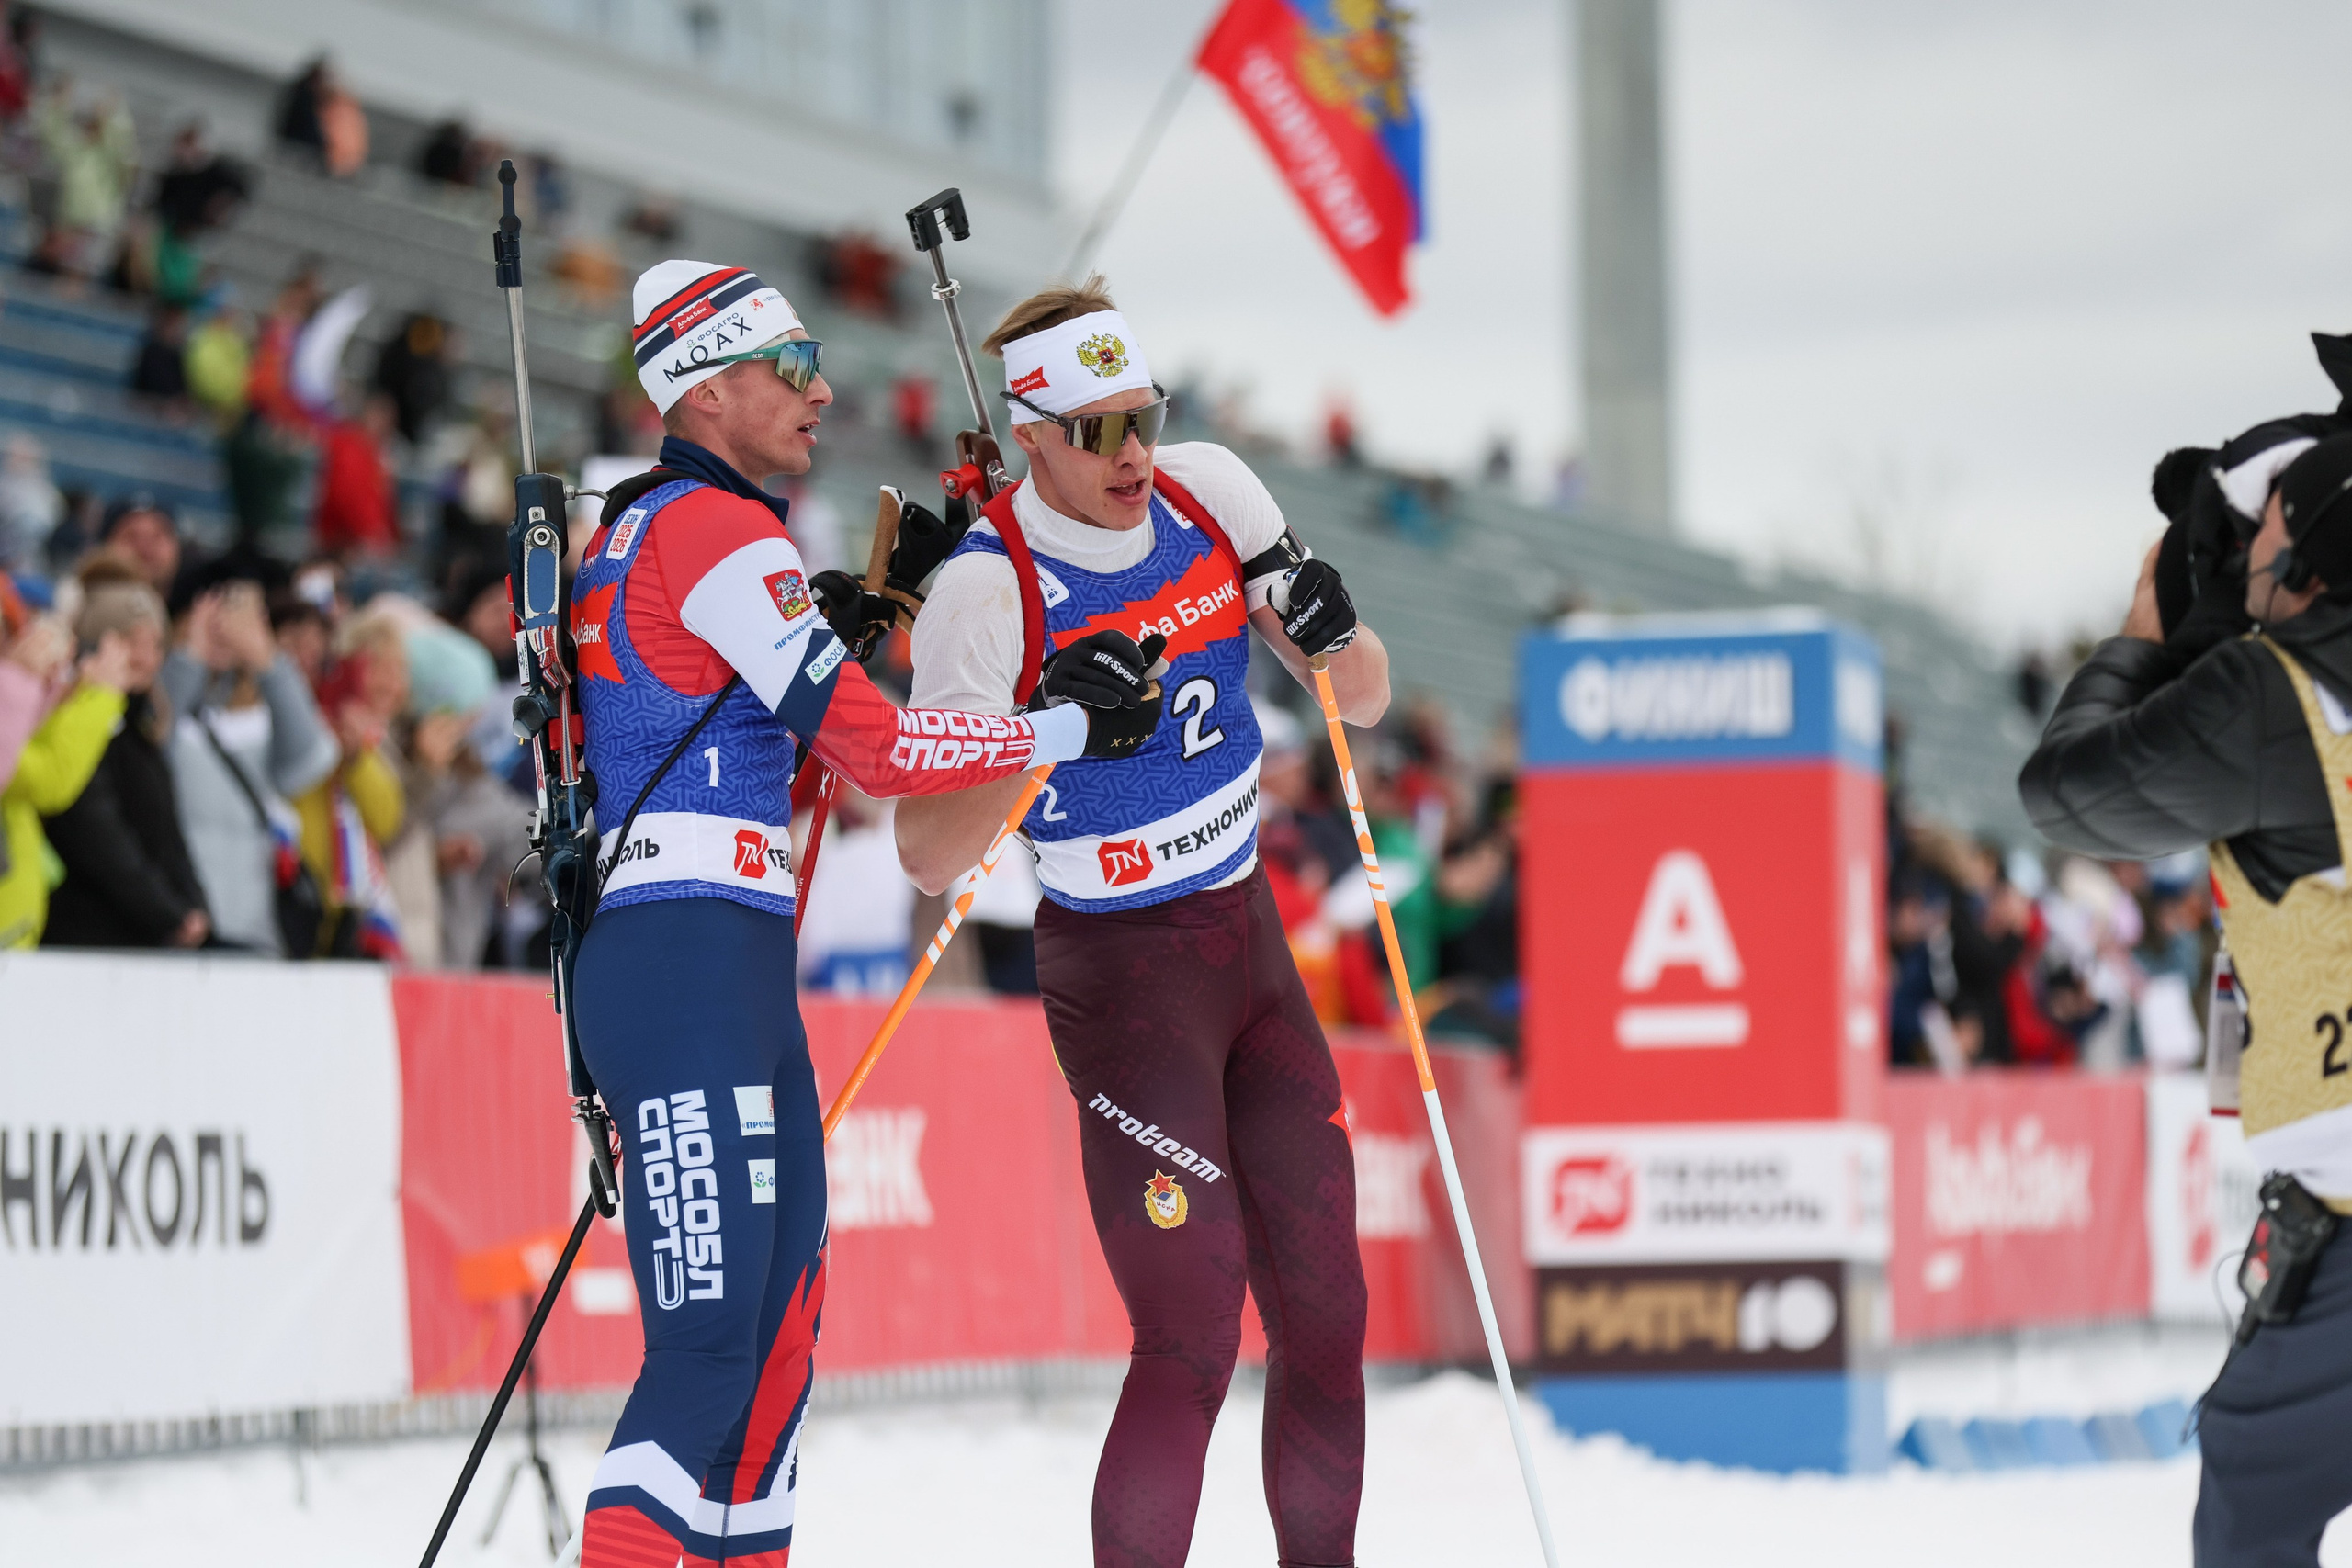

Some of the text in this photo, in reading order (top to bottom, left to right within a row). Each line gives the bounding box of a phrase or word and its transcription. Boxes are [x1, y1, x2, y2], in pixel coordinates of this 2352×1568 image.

[697, 312, 739, 341] ФОСАГРО
[1173, 578, 1239, 627] Банк
[1170, 675, 1226, 761] 2
[704, 746, 720, 788] 1
[889, 735, 1004, 771] СПОРТ
[1038, 784, 1068, 822] 2
[2315, 1006, 2352, 1079] 2
[638, 1097, 683, 1258] СПОРТ
